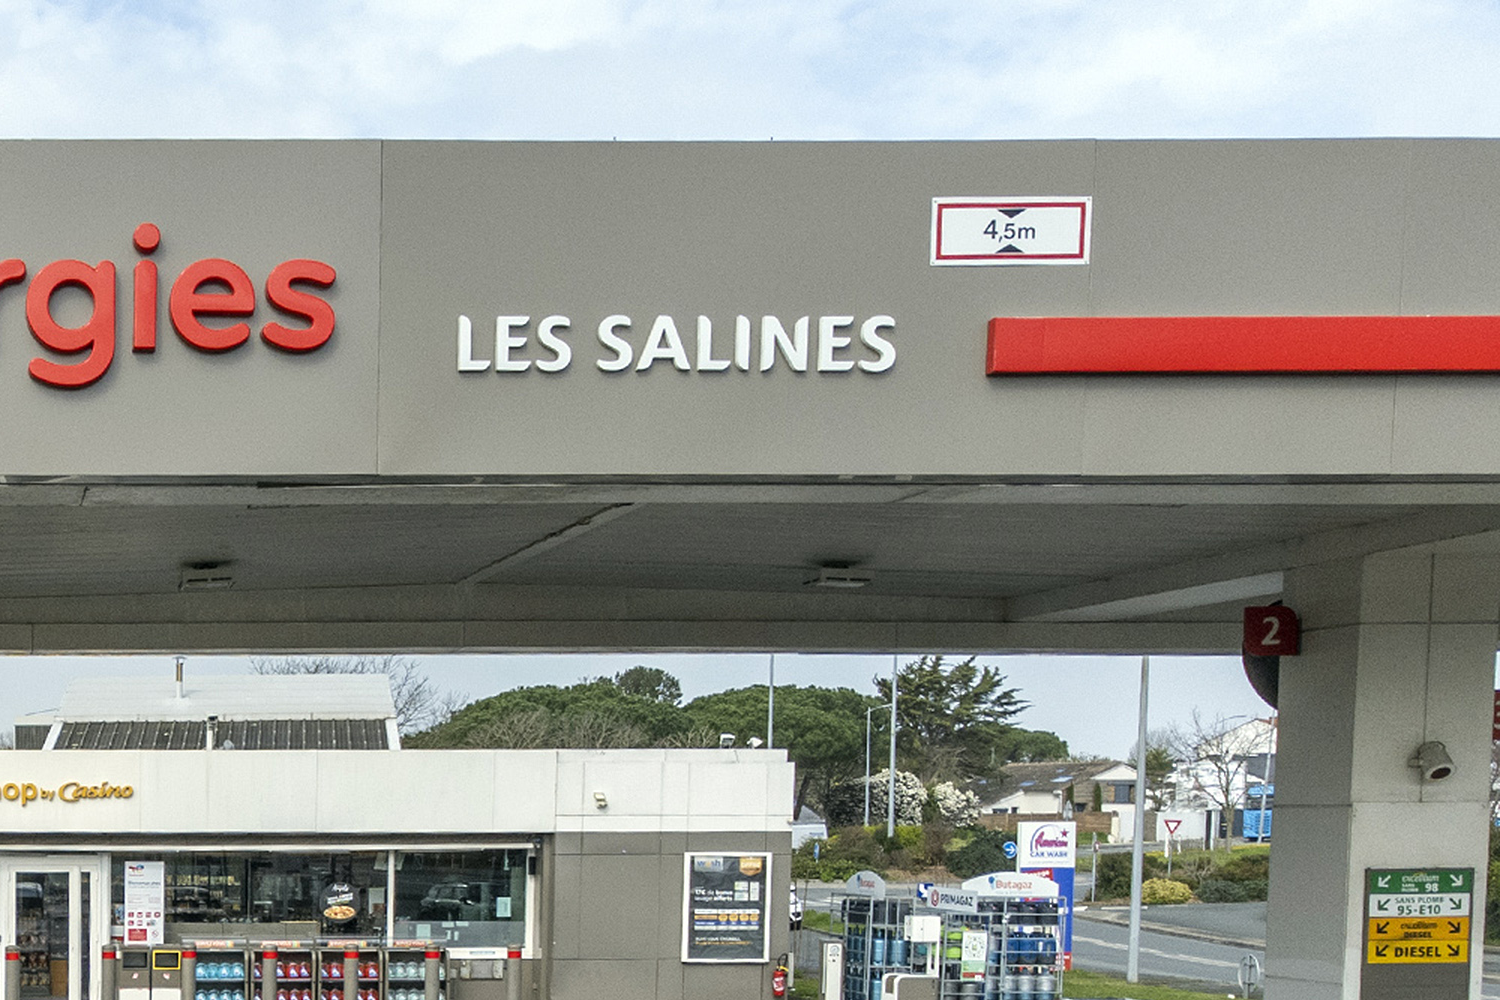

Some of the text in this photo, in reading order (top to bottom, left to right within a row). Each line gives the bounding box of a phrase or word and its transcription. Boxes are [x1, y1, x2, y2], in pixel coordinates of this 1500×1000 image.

[983, 219, 1037, 243] 4,5m
[457, 314, 897, 373] LES SALINES
[1260, 615, 1282, 646] 2
[40, 787, 55, 802] by
[58, 781, 134, 803] Casino
[1047, 850, 1068, 858] WASH
[995, 879, 1033, 891] Butagaz
[1424, 882, 1439, 892] 98
[940, 892, 974, 907] PRIMAGAZ
[1395, 896, 1416, 904] SANS
[1397, 904, 1441, 916] 95-E10
[1394, 946, 1442, 958] DIESEL
